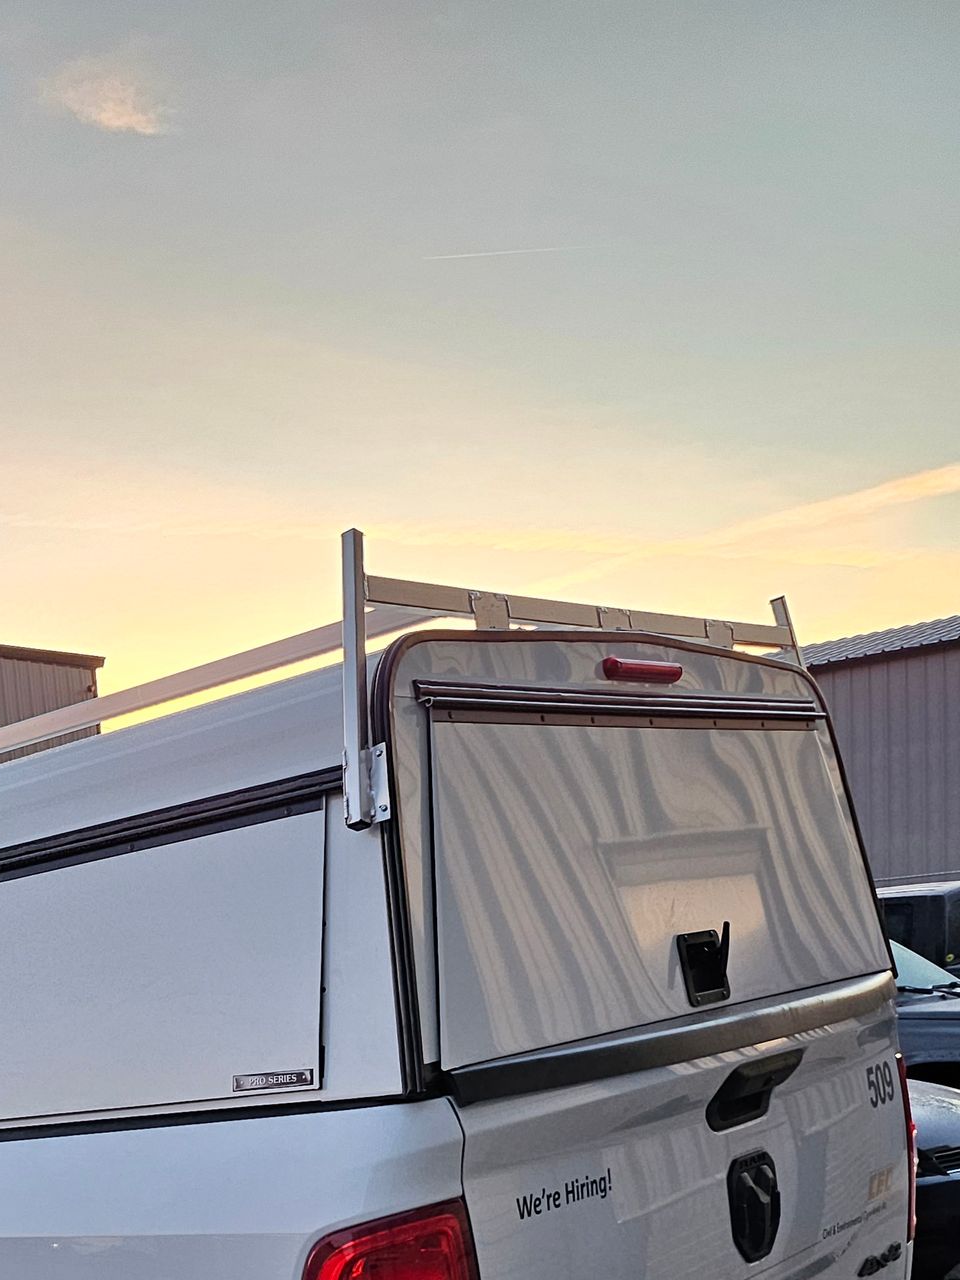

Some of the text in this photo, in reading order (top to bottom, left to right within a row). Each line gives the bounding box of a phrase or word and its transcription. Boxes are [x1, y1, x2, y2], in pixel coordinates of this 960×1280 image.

[268, 1073, 297, 1085] SERIES
[866, 1060, 894, 1108] 509
[564, 1168, 612, 1205] Hiring!
